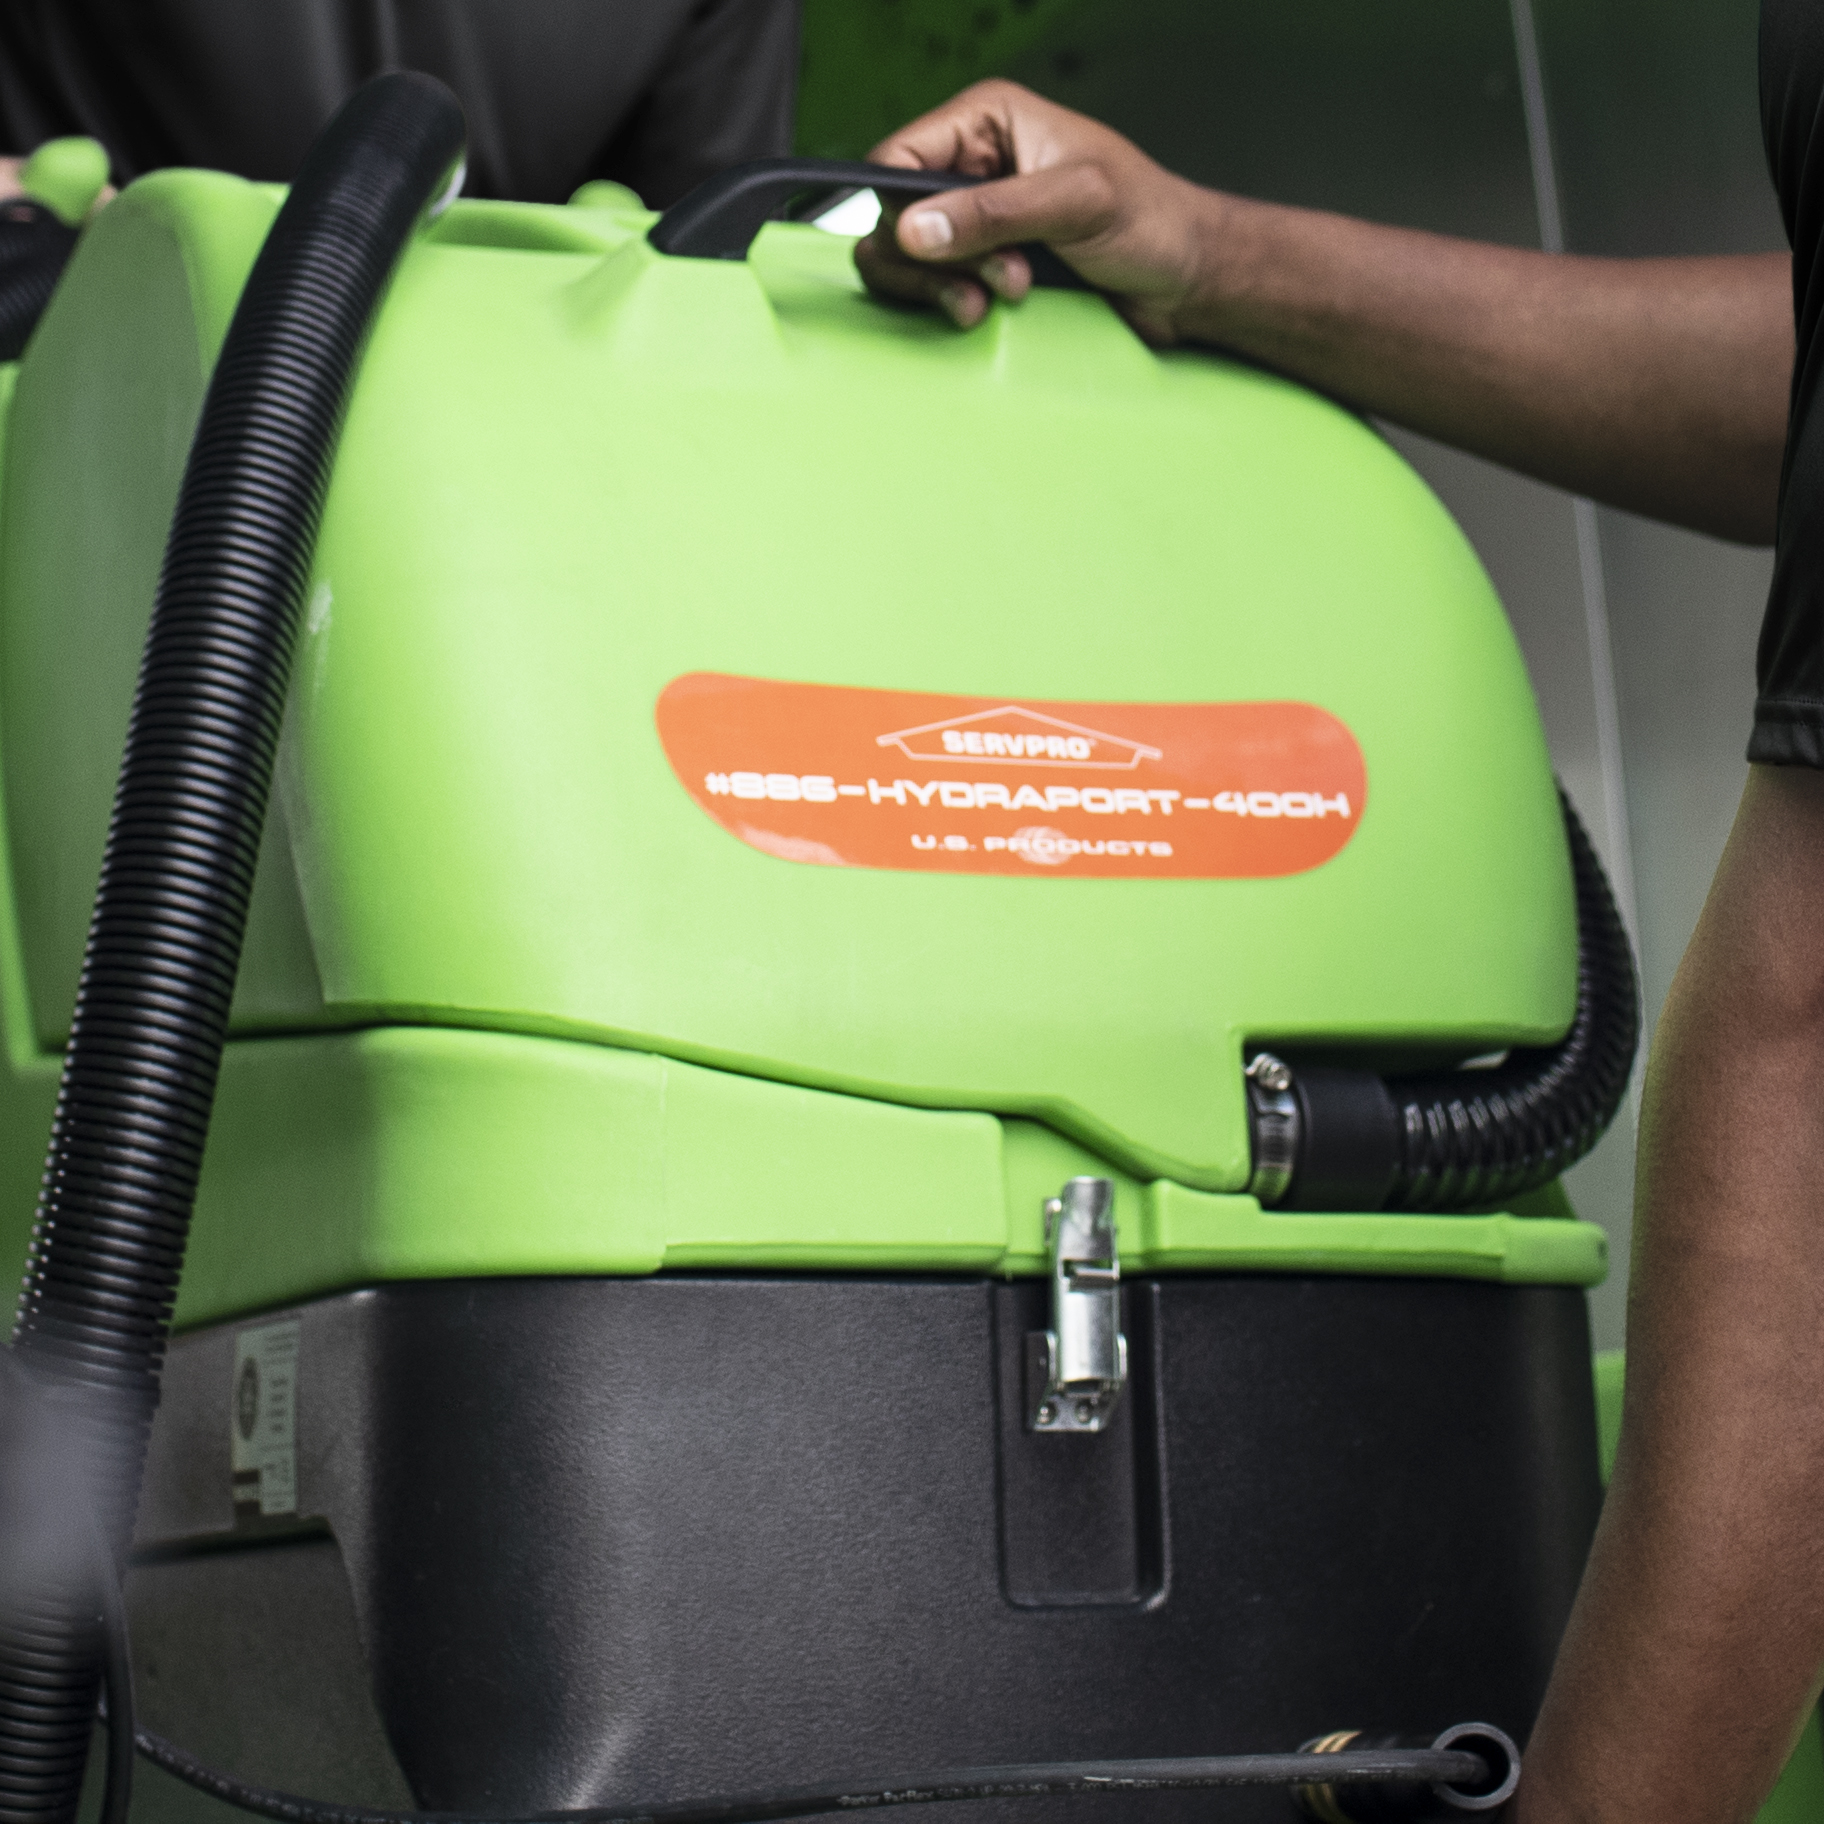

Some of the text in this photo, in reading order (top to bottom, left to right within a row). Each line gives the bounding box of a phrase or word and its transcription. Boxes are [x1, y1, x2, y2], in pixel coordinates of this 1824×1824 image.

[942, 730, 1091, 760] SERVPRO
[910, 833, 1174, 858] U.S. PRODUCTS
